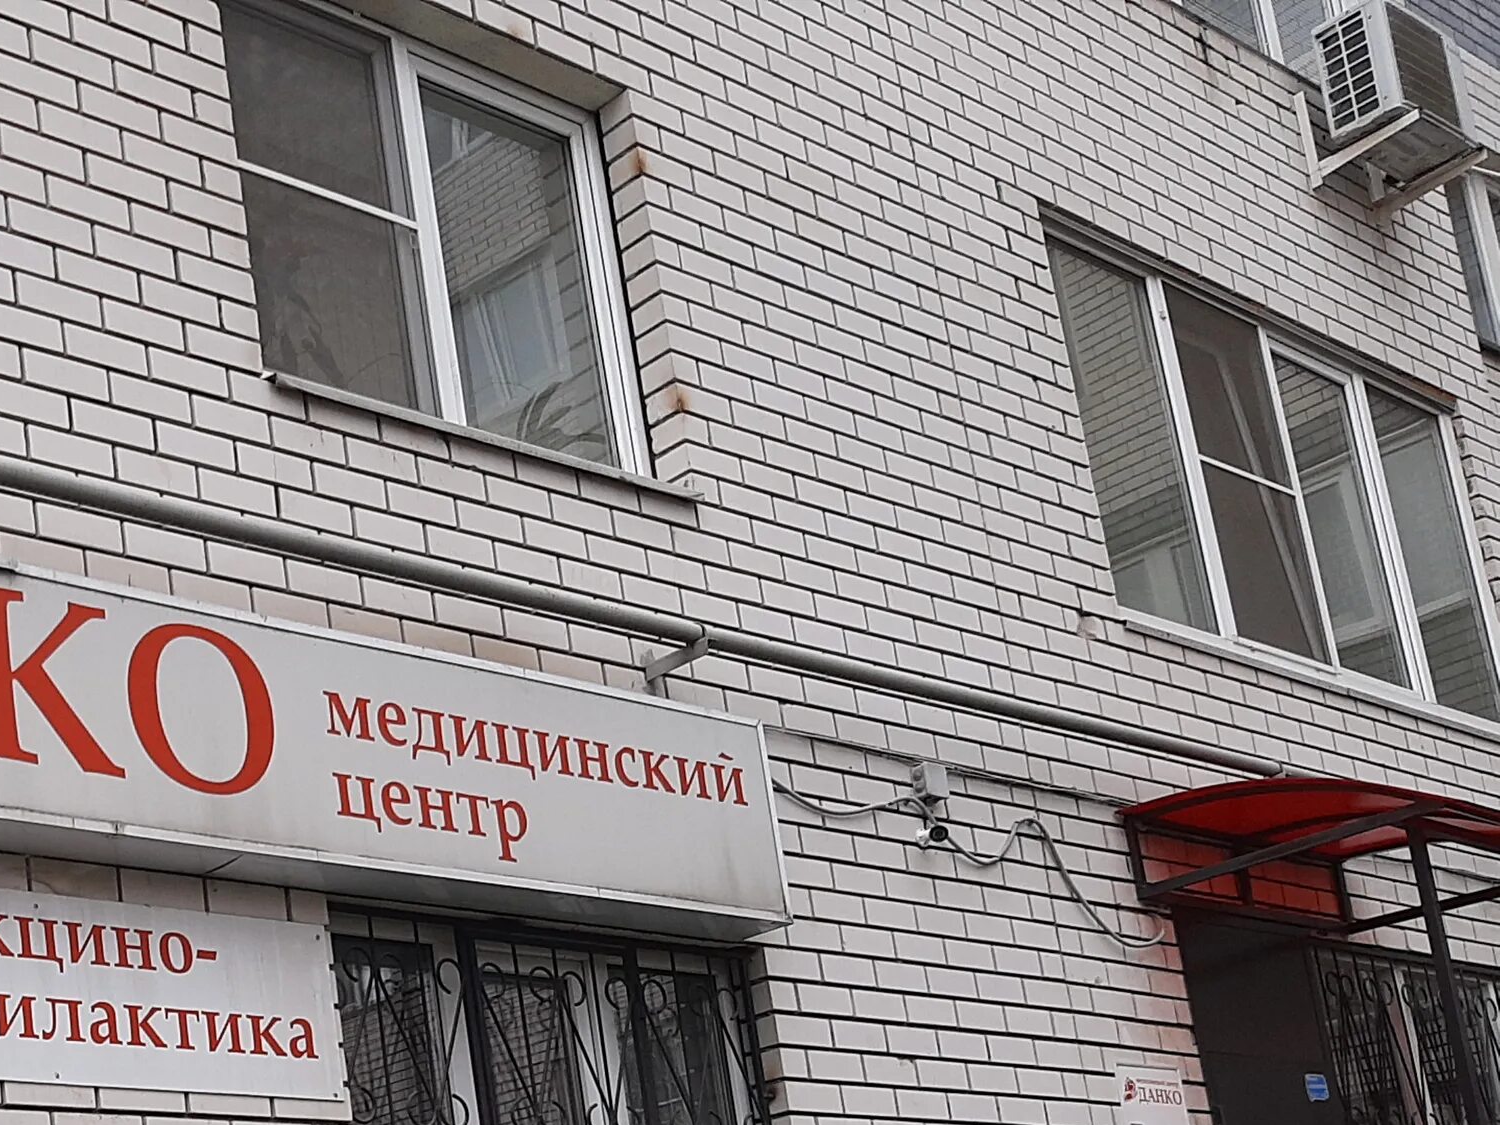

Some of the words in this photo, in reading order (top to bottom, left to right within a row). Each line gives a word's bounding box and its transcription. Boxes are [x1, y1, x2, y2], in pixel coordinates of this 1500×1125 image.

[323, 690, 749, 806] медицинский
[332, 772, 528, 863] центр
[1138, 1086, 1183, 1105] ДАНКО
